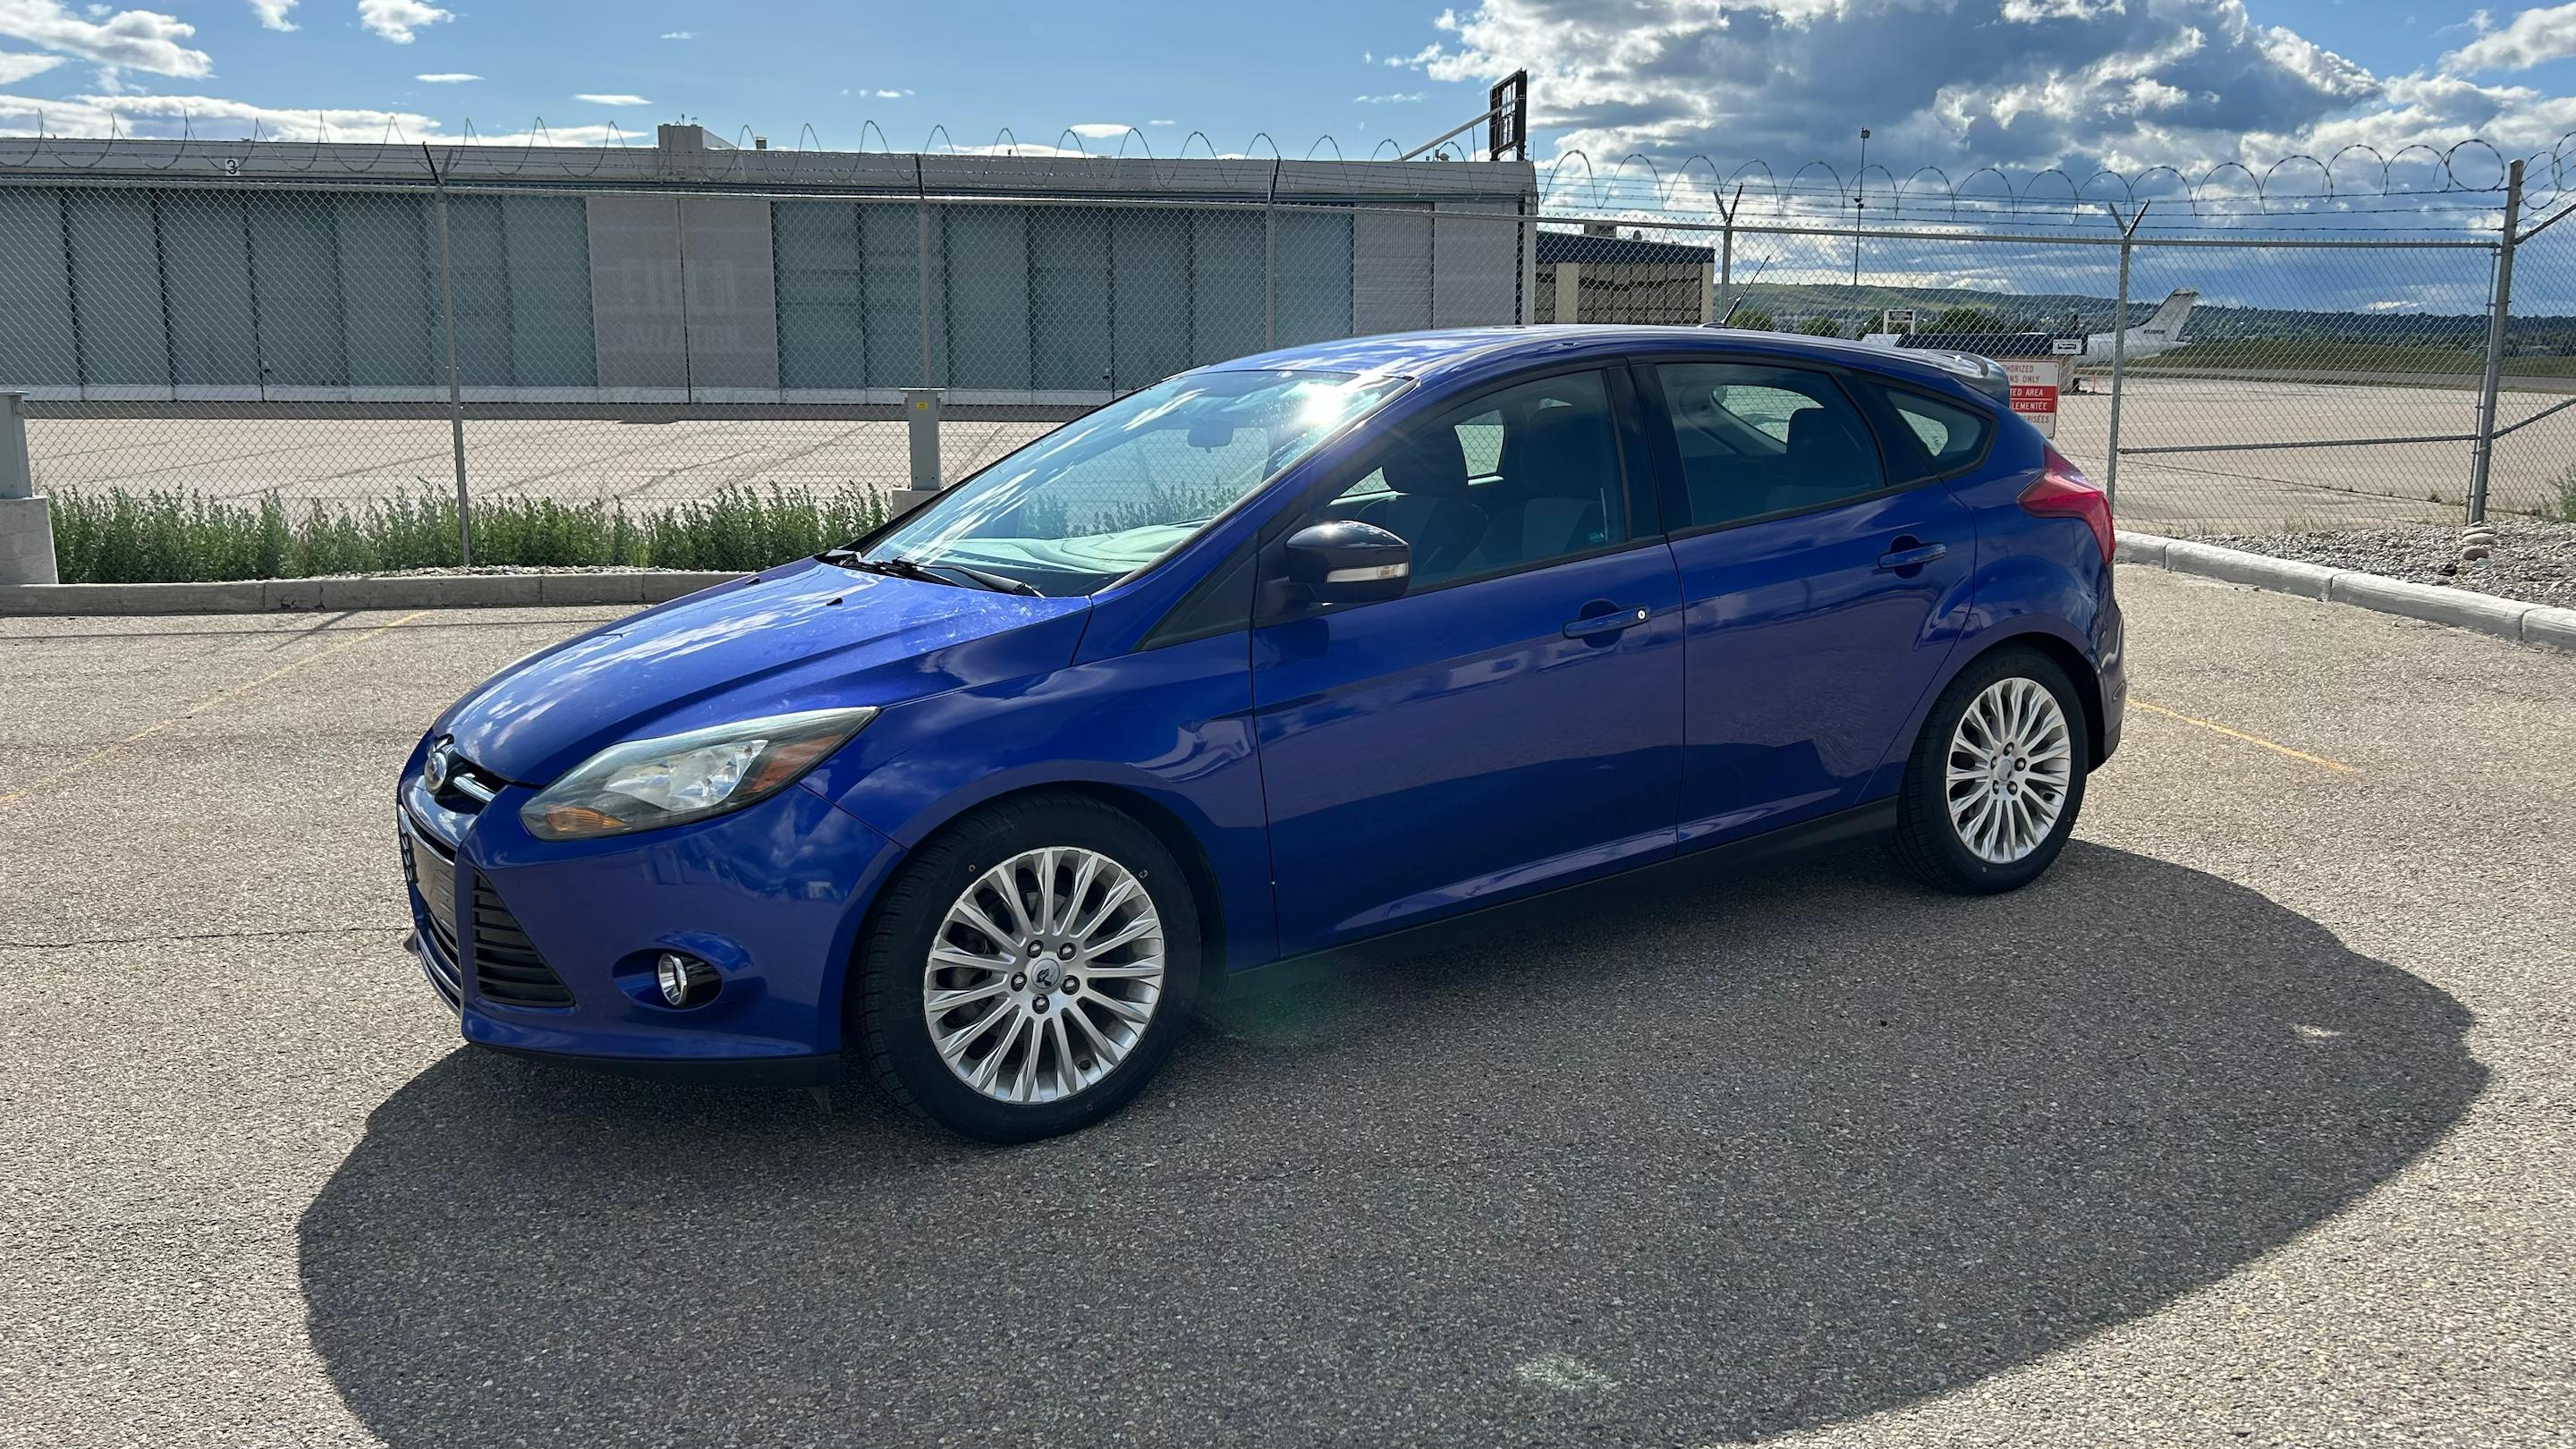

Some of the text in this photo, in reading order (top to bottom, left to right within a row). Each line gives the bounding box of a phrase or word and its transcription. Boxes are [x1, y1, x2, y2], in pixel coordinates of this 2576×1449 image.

[227, 159, 237, 174] 3
[2022, 375, 2039, 383] ONLY
[2025, 387, 2043, 396] AREA
